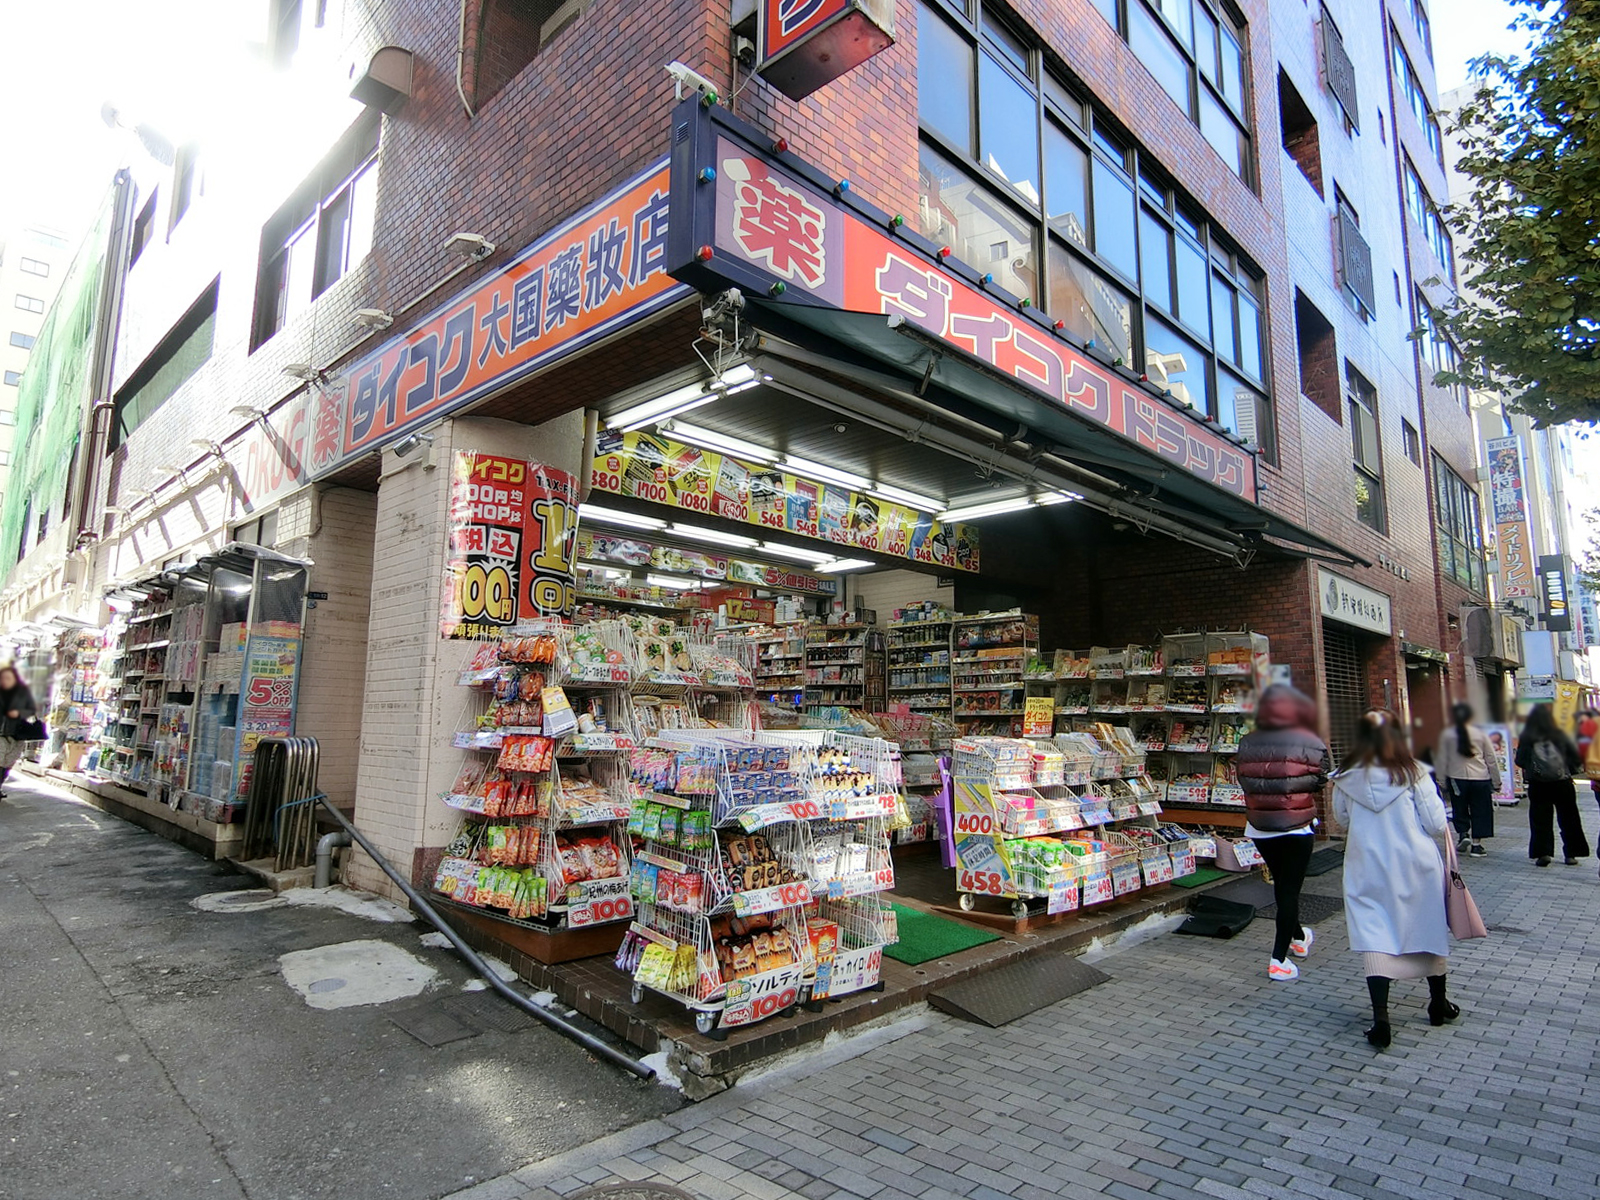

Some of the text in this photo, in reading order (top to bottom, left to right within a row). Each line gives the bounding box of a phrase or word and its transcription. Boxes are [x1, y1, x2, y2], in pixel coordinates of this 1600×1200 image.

[312, 388, 345, 466] 薬
[242, 407, 306, 505] DRUG
[637, 481, 667, 501] 1700
[1492, 471, 1518, 506] 特撮
[681, 491, 708, 512] 1080
[1497, 505, 1518, 513] BAR
[761, 511, 785, 528] 548
[796, 519, 817, 537] 548
[859, 534, 878, 549] 420
[888, 541, 906, 555] 400
[915, 547, 932, 562] 348
[940, 553, 955, 567] 298
[1500, 524, 1527, 581] メイドリフレ
[964, 559, 979, 571] 85
[765, 567, 818, 591] 5%値引き
[818, 581, 836, 592] SALE
[611, 668, 630, 681] 100
[683, 675, 699, 685] 100
[737, 676, 752, 686] 100
[272, 696, 291, 706] OFF
[614, 738, 633, 749] 100
[787, 801, 819, 820] 100
[879, 796, 895, 809] 78
[613, 807, 630, 818] 100
[958, 814, 992, 834] 400
[1184, 855, 1195, 869] 128
[875, 869, 893, 885] 198
[960, 870, 1002, 895] 458
[588, 881, 630, 900] 紀州の梅あげ
[779, 883, 810, 905] 100
[1064, 887, 1078, 904] 198
[591, 898, 631, 921] 100
[833, 957, 864, 977] ホッカイロ
[866, 949, 882, 972] 498
[752, 971, 801, 994] ソルティ
[751, 988, 797, 1020] 100
